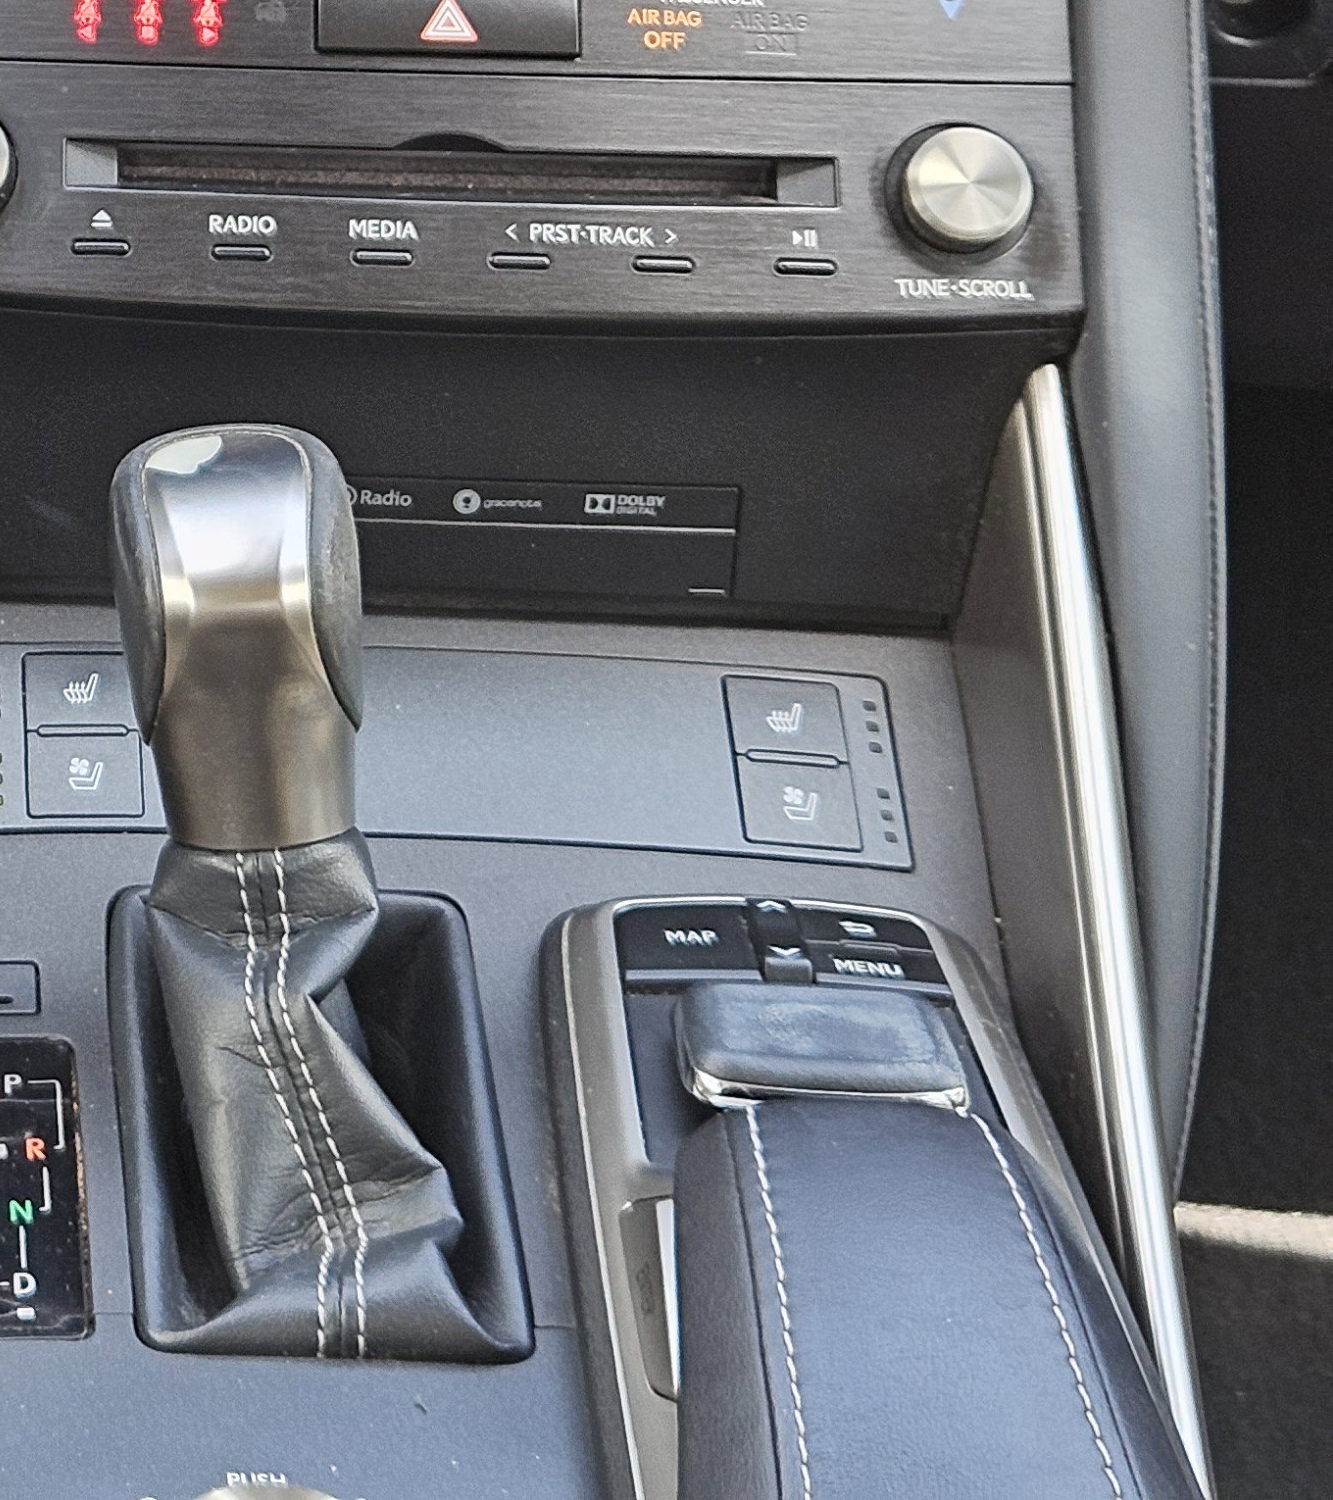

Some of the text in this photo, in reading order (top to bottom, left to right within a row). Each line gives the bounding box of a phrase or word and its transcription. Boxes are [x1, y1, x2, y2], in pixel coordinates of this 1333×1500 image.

[628, 8, 703, 27] AIR BAG
[643, 30, 686, 50] OFF
[208, 214, 277, 236] RADIO
[348, 218, 419, 242] MEDIA
[360, 488, 412, 507] Radio
[617, 494, 666, 508] DOLBY
[664, 929, 719, 947] MAP
[833, 957, 904, 979] MENU
[4, 1074, 22, 1095] P
[25, 1137, 47, 1160] R
[9, 1200, 33, 1225] N
[13, 1272, 37, 1297] D
